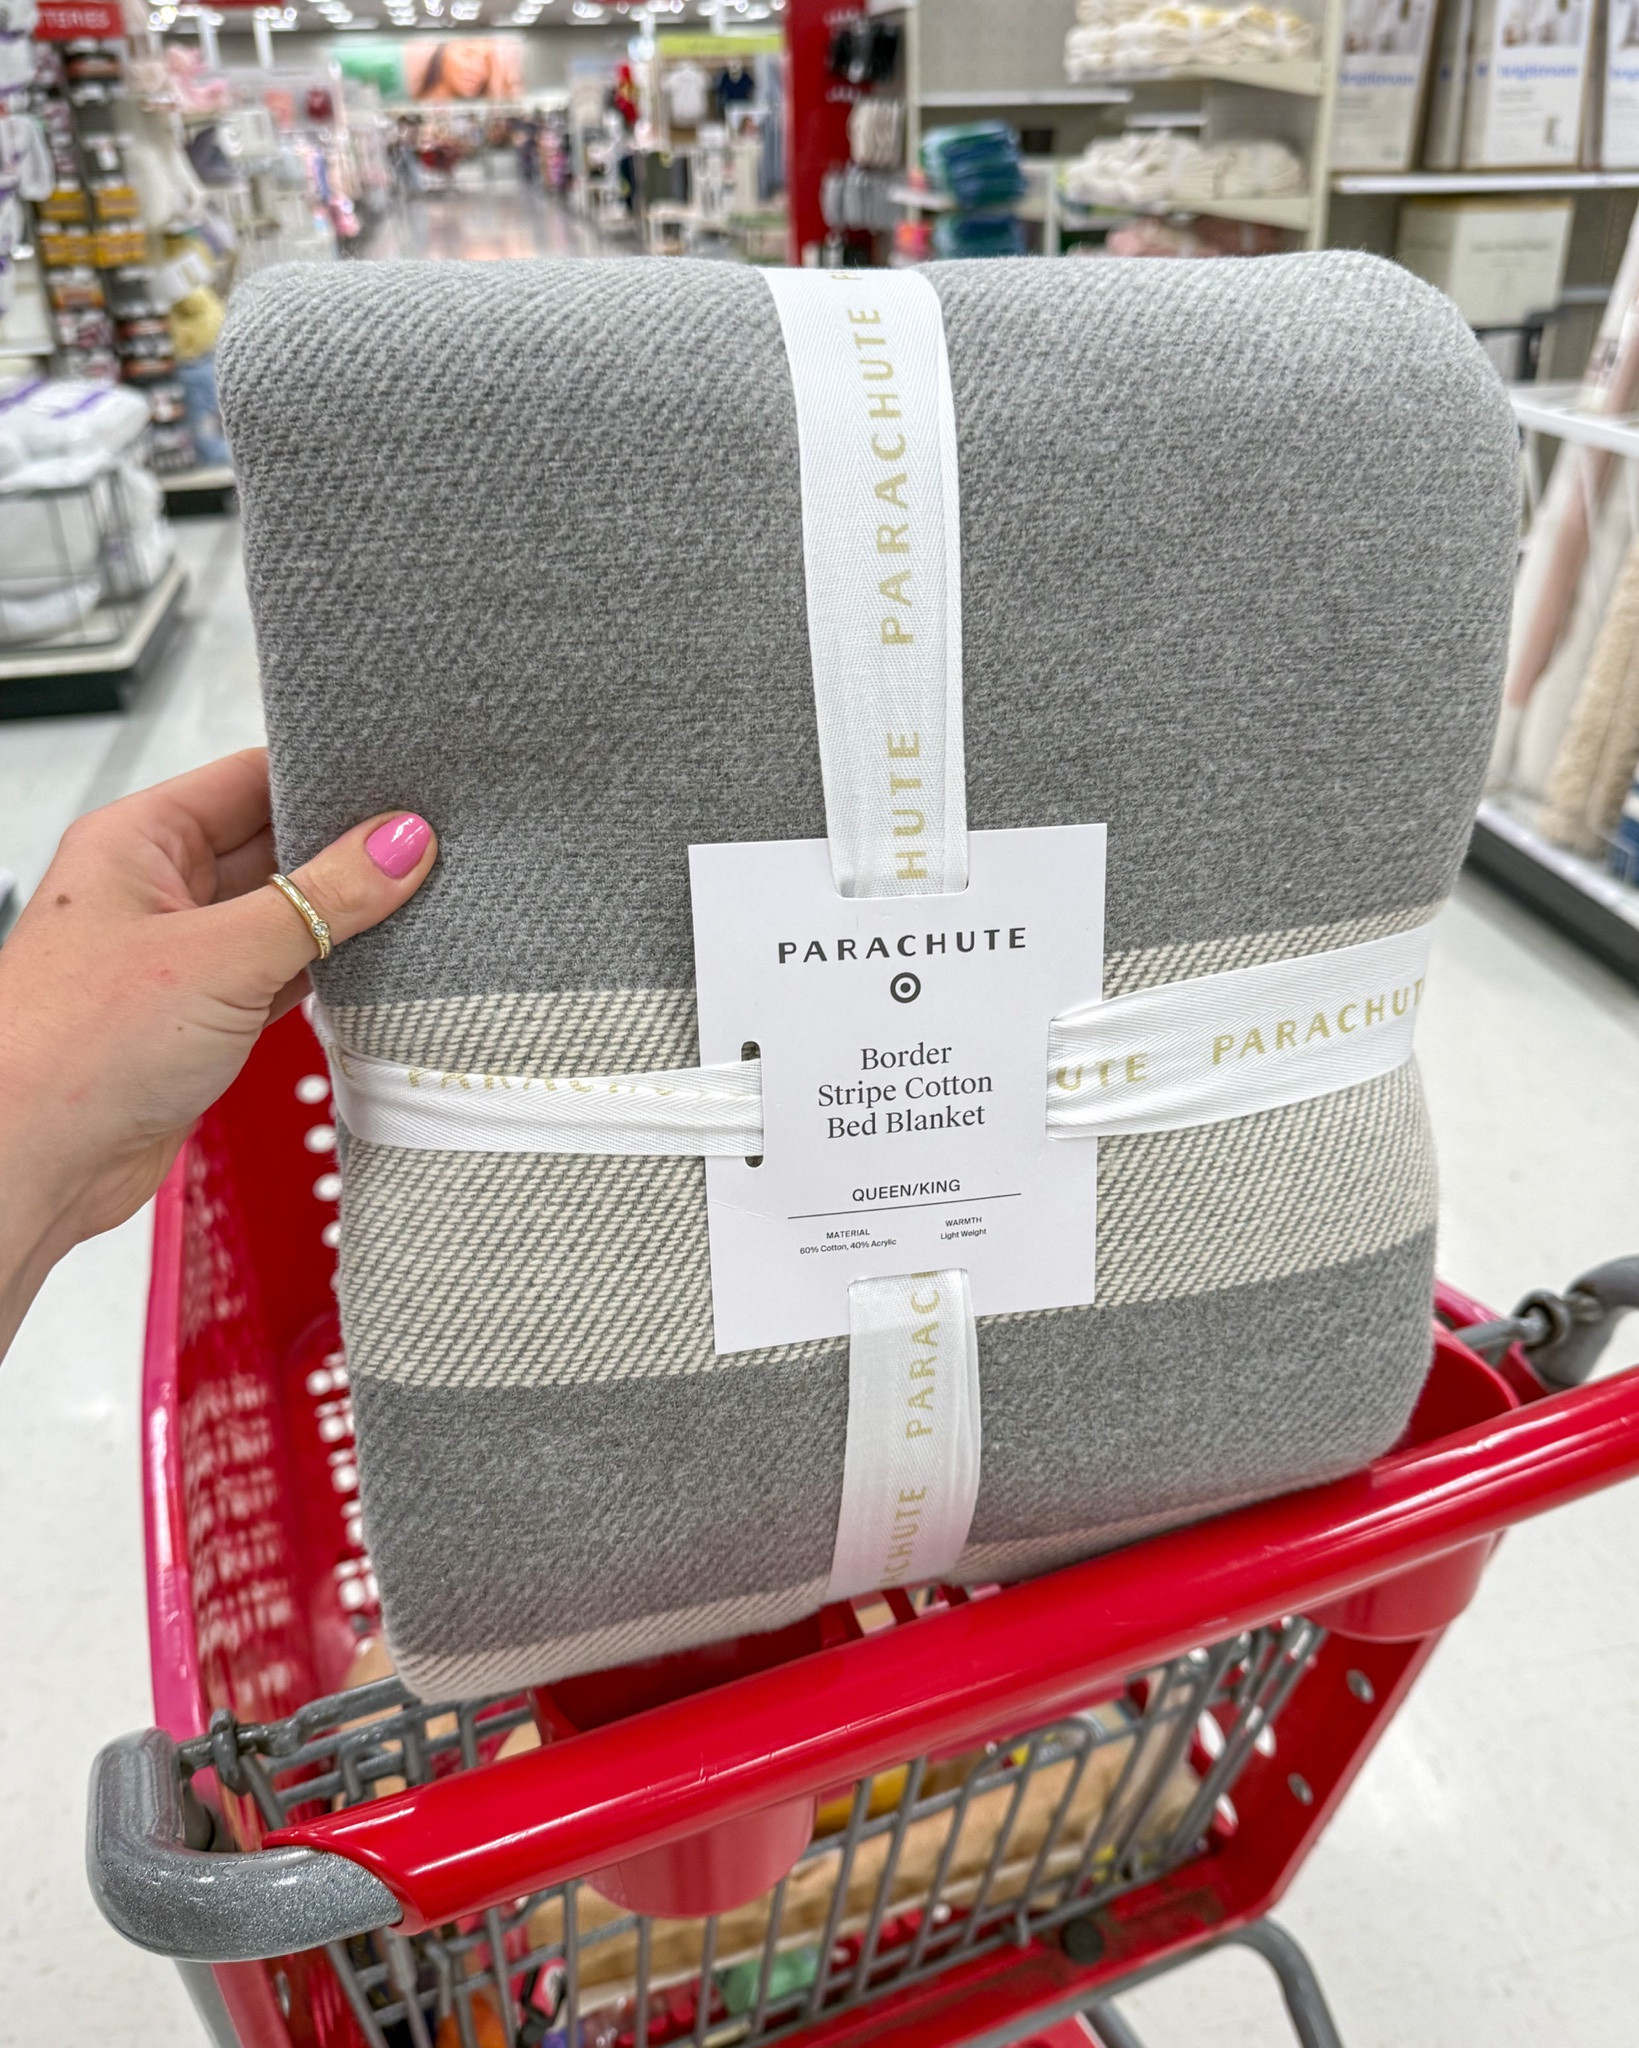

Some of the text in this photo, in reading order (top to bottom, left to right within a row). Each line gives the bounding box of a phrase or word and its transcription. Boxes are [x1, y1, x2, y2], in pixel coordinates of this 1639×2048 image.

[847, 309, 928, 881] HUTE PARACHUTE
[777, 927, 1027, 964] PARACHUTE
[861, 1041, 953, 1071] Border
[818, 1075, 993, 1109] Stripe Cotton
[828, 1104, 985, 1139] Bed Blanket
[852, 1178, 961, 1202] QUEEN/KING
[826, 1229, 870, 1240] MATERIAL
[940, 1228, 987, 1241] Light Weight
[945, 1216, 982, 1227] WARMTH
[799, 1238, 897, 1255] 60% Cotton, 40% Acrylic
[905, 1271, 940, 1439] PARAC
